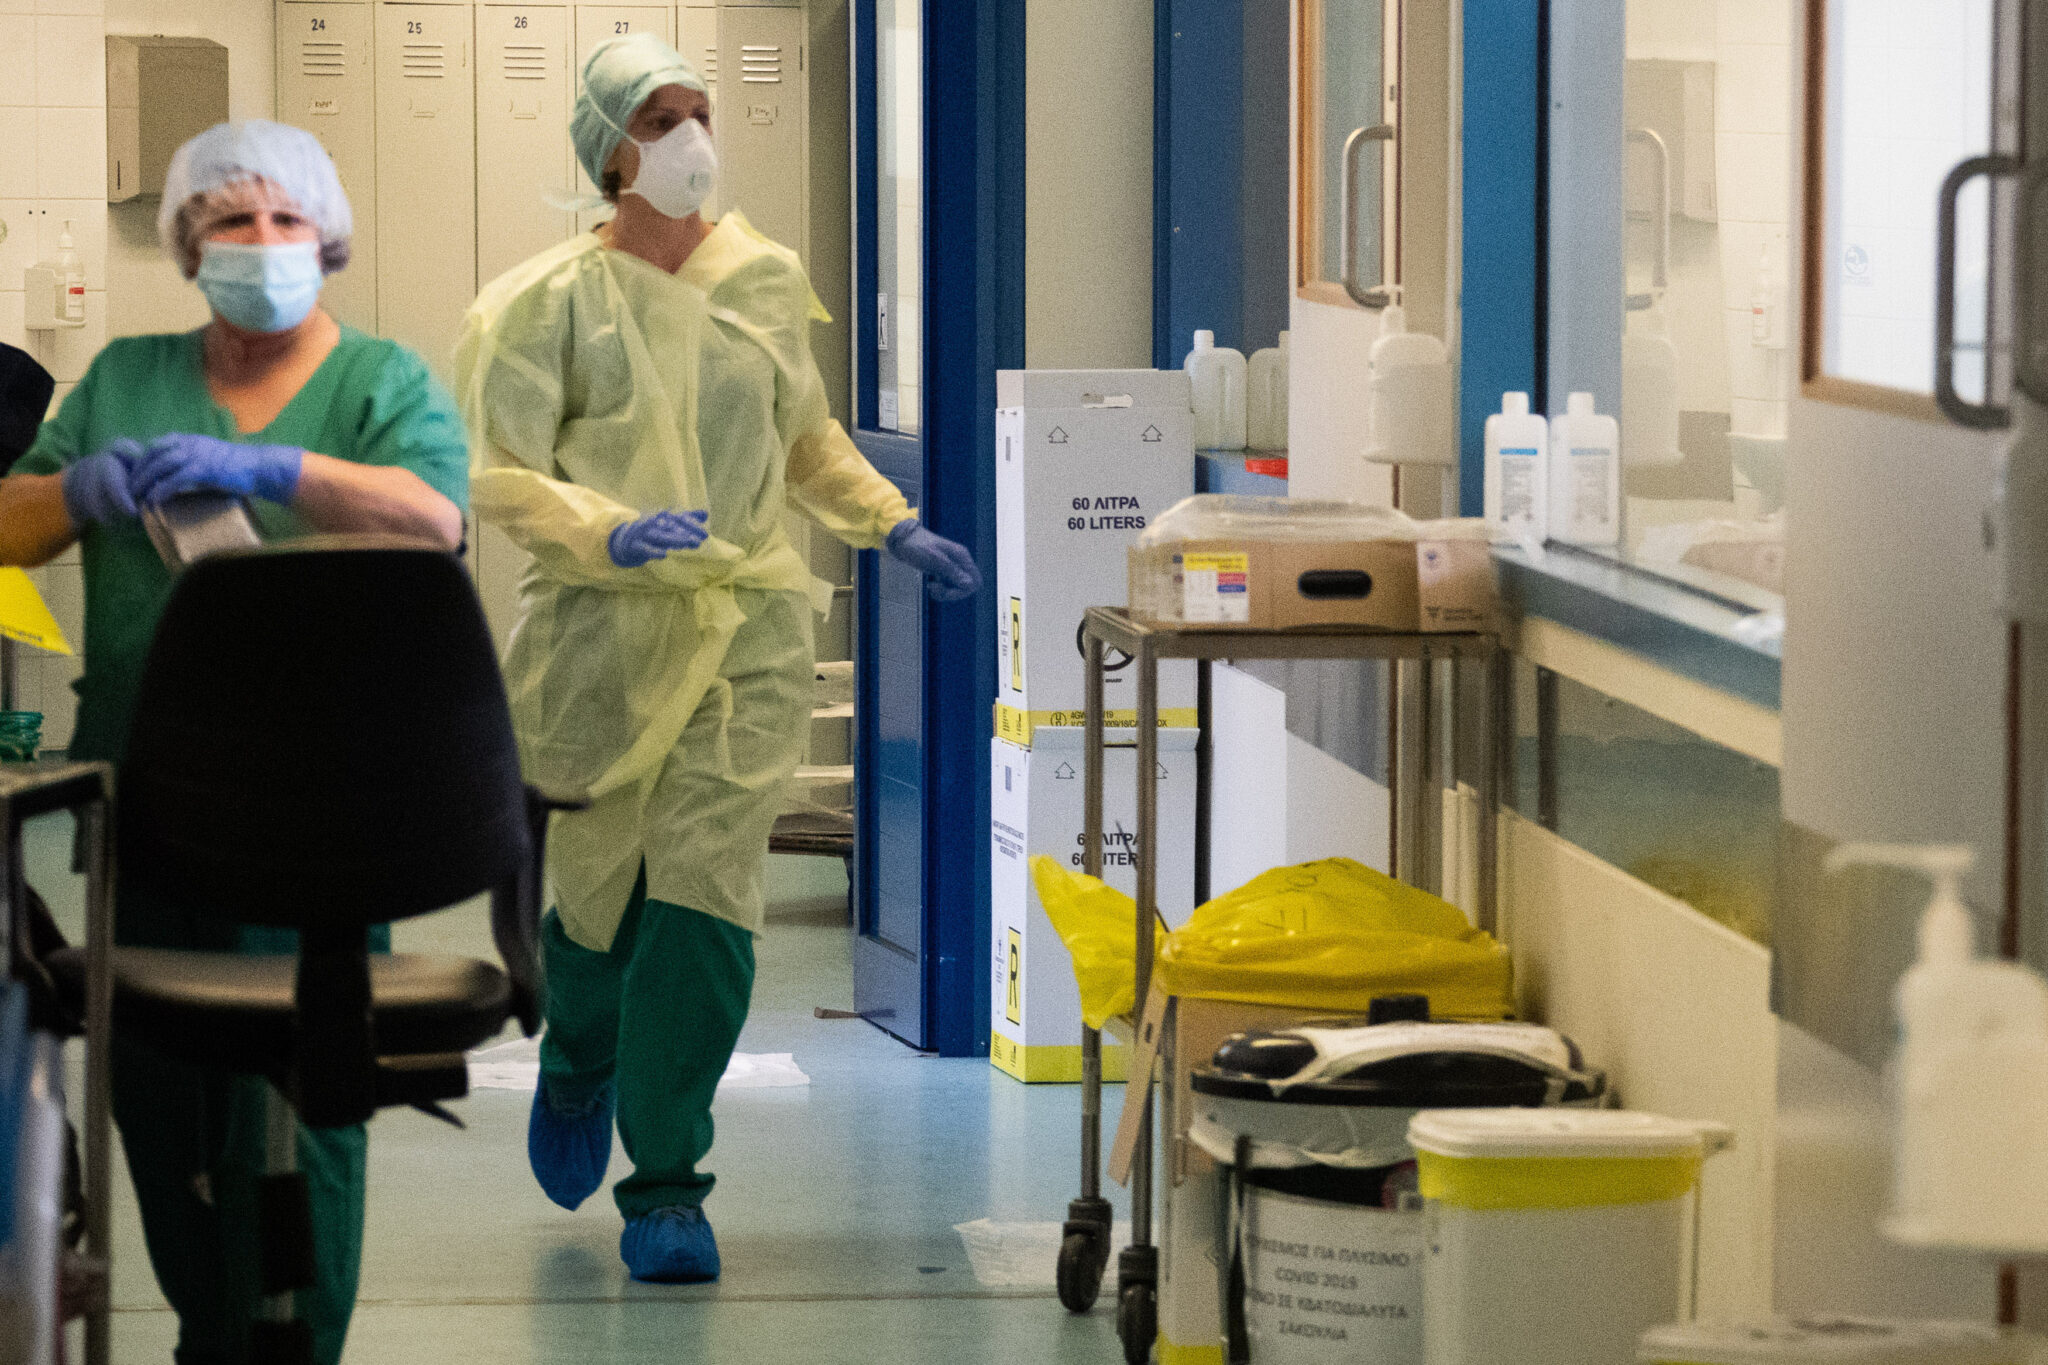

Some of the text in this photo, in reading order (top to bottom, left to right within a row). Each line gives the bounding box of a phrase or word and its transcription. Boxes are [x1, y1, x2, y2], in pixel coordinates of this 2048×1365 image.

[311, 18, 326, 31] 24
[407, 21, 423, 34] 25
[514, 16, 528, 29] 26
[615, 21, 629, 34] 27
[1072, 496, 1141, 511] 60 ΛΙΤΡΑ
[1067, 516, 1146, 531] 60 LITERS
[1275, 1266, 1319, 1285] COVID
